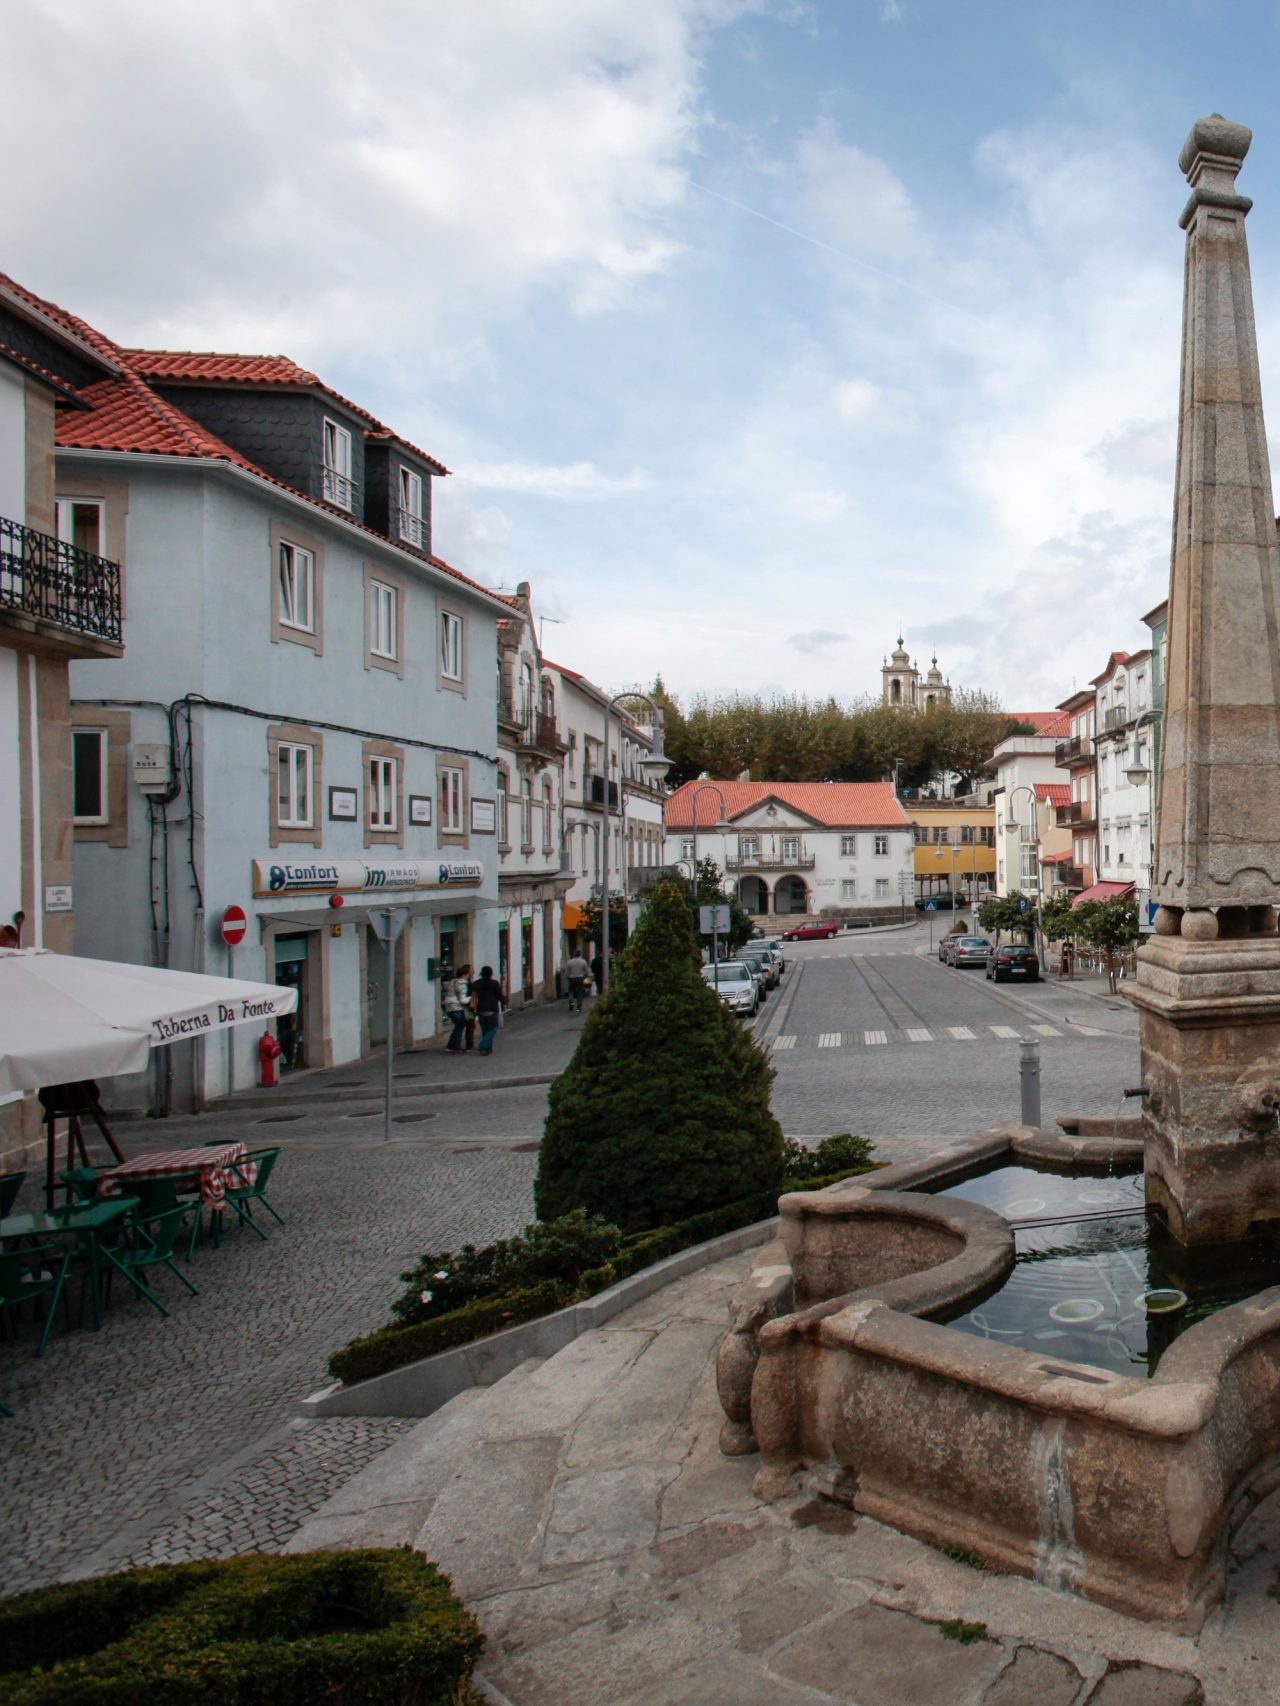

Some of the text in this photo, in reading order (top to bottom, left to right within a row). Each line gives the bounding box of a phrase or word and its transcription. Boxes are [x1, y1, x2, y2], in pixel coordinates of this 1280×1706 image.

[285, 865, 339, 879] Confort
[448, 864, 481, 875] Confort
[152, 1000, 276, 1040] Taberna Da Fonte
